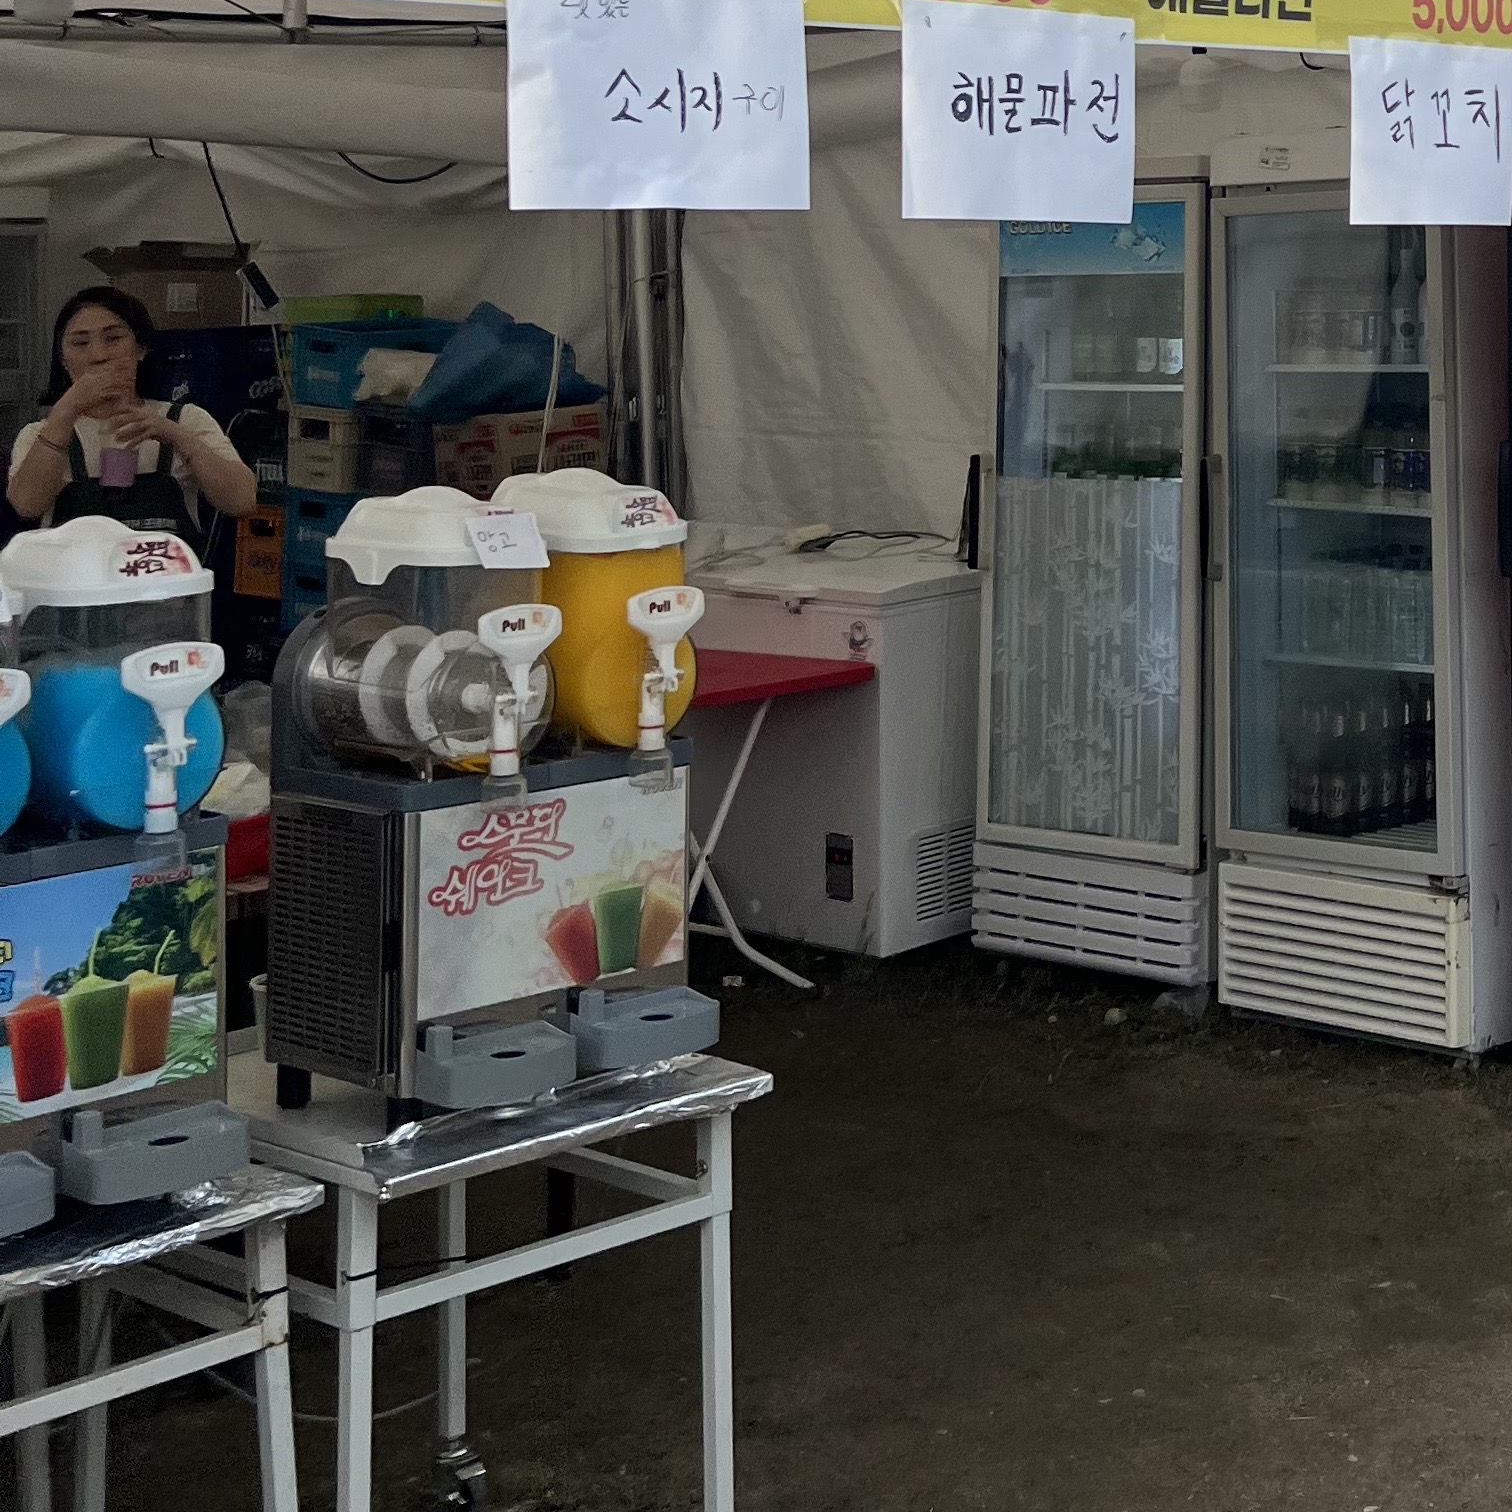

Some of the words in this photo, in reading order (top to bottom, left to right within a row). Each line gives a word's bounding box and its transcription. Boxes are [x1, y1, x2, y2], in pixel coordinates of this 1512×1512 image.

[604, 68, 723, 133] 소시지
[732, 83, 785, 121] 구이
[950, 69, 1121, 143] 해물파전
[1381, 77, 1502, 163] 닭꼬치
[502, 618, 526, 633] Pull
[650, 600, 671, 614] Pull
[150, 659, 179, 676] Pull
